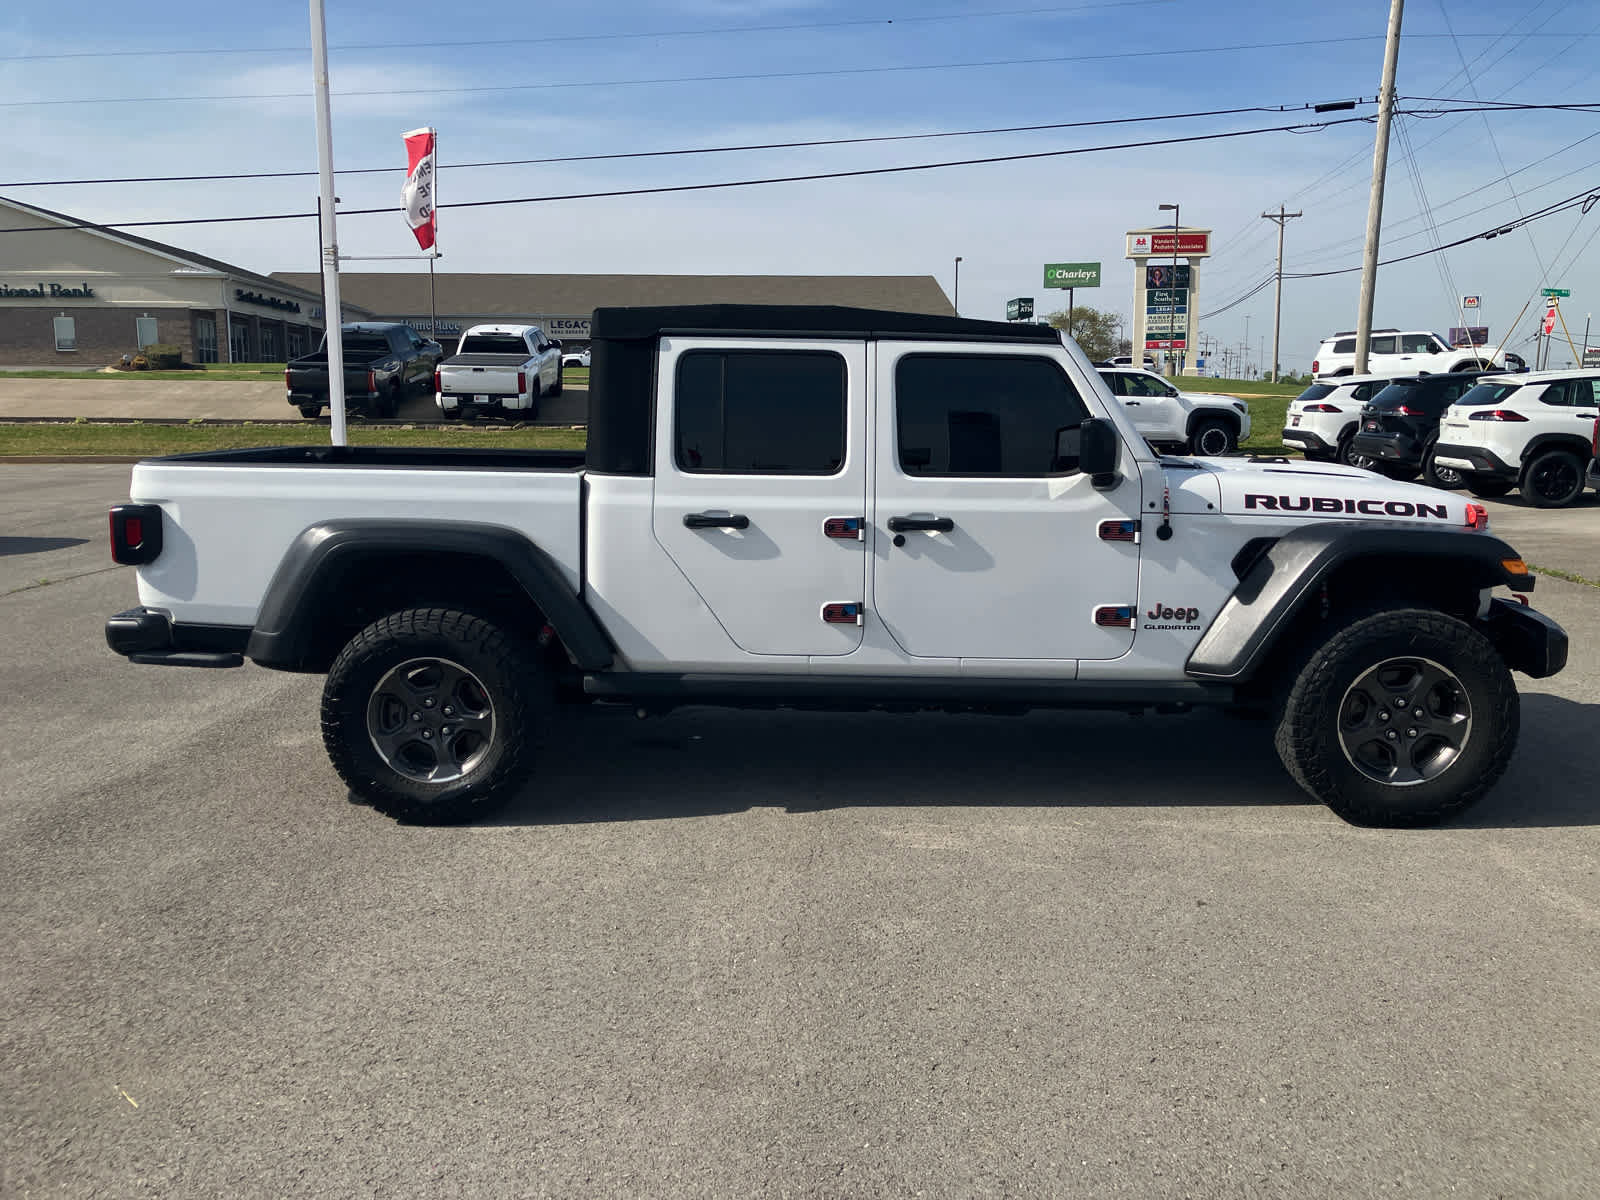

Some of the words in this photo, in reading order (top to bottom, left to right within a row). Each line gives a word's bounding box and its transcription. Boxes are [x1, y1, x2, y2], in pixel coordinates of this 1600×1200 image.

[48, 283, 96, 298] Bank
[1244, 493, 1448, 520] RUBICON
[1147, 602, 1200, 624] Jeep
